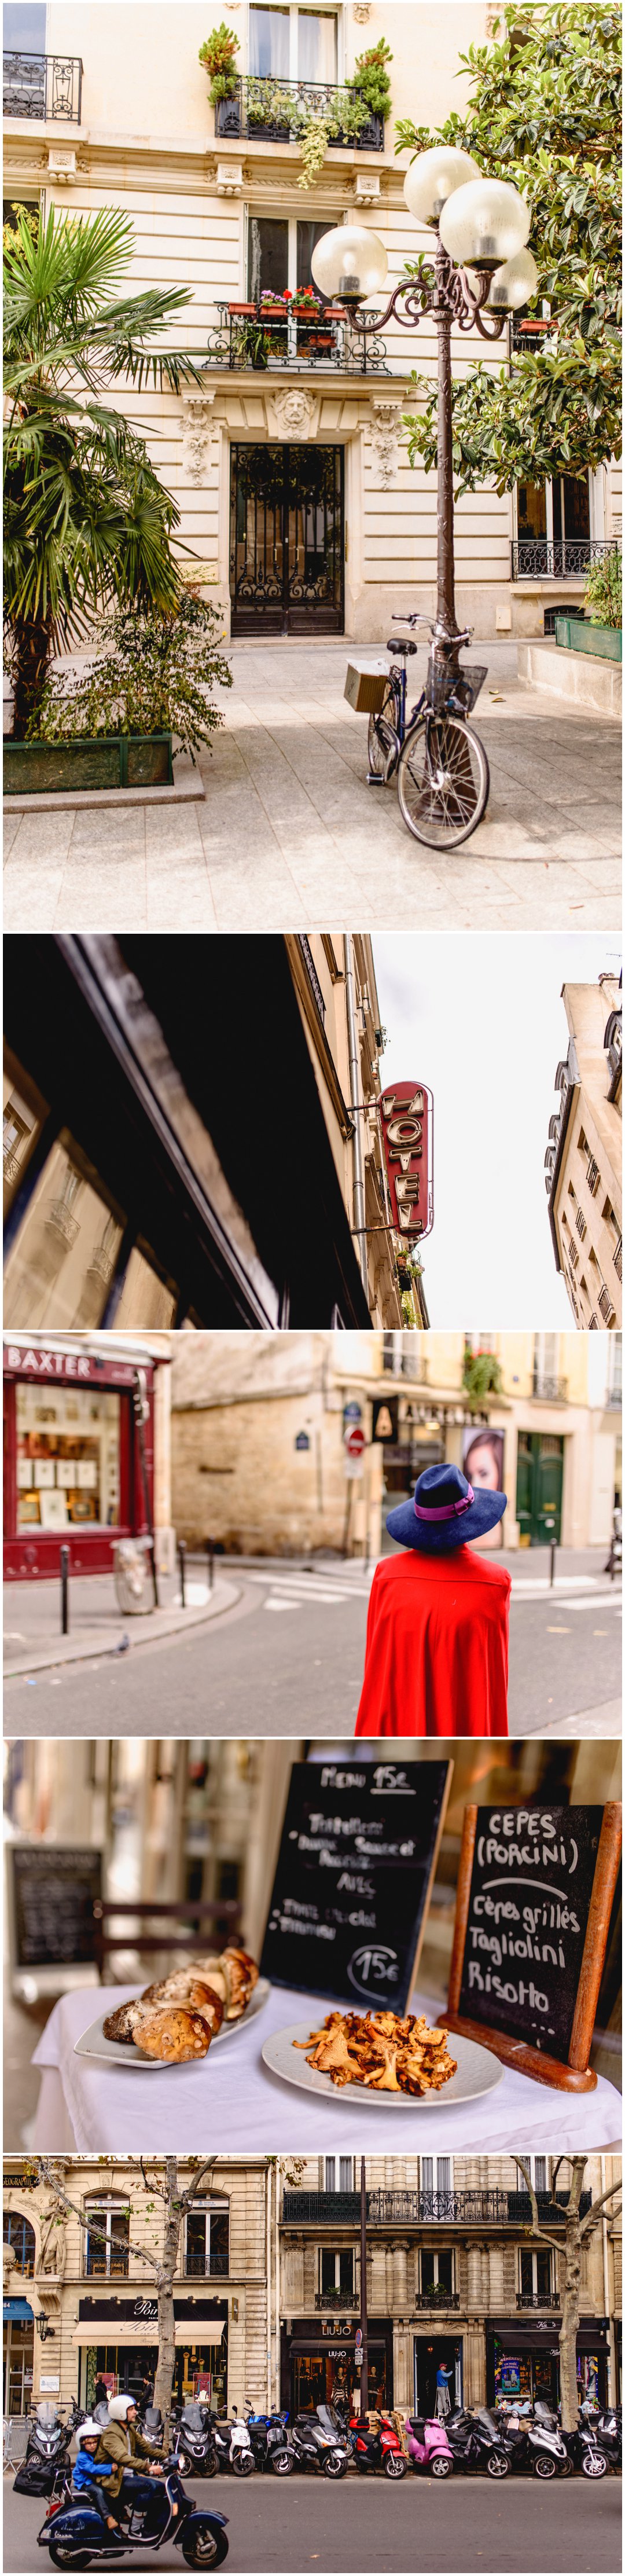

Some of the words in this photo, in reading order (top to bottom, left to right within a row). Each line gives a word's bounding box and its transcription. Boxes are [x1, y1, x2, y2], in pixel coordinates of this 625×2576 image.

[382, 1090, 424, 1231] HOTEL
[8, 1346, 91, 1377] BAXTER
[373, 1766, 411, 1788] 15€
[489, 1811, 557, 1839] CEPES
[469, 1927, 566, 1968] Tagliolini
[356, 1951, 400, 1981] 15€
[468, 1961, 549, 2013] Risotto
[134, 2300, 158, 2315] Poir
